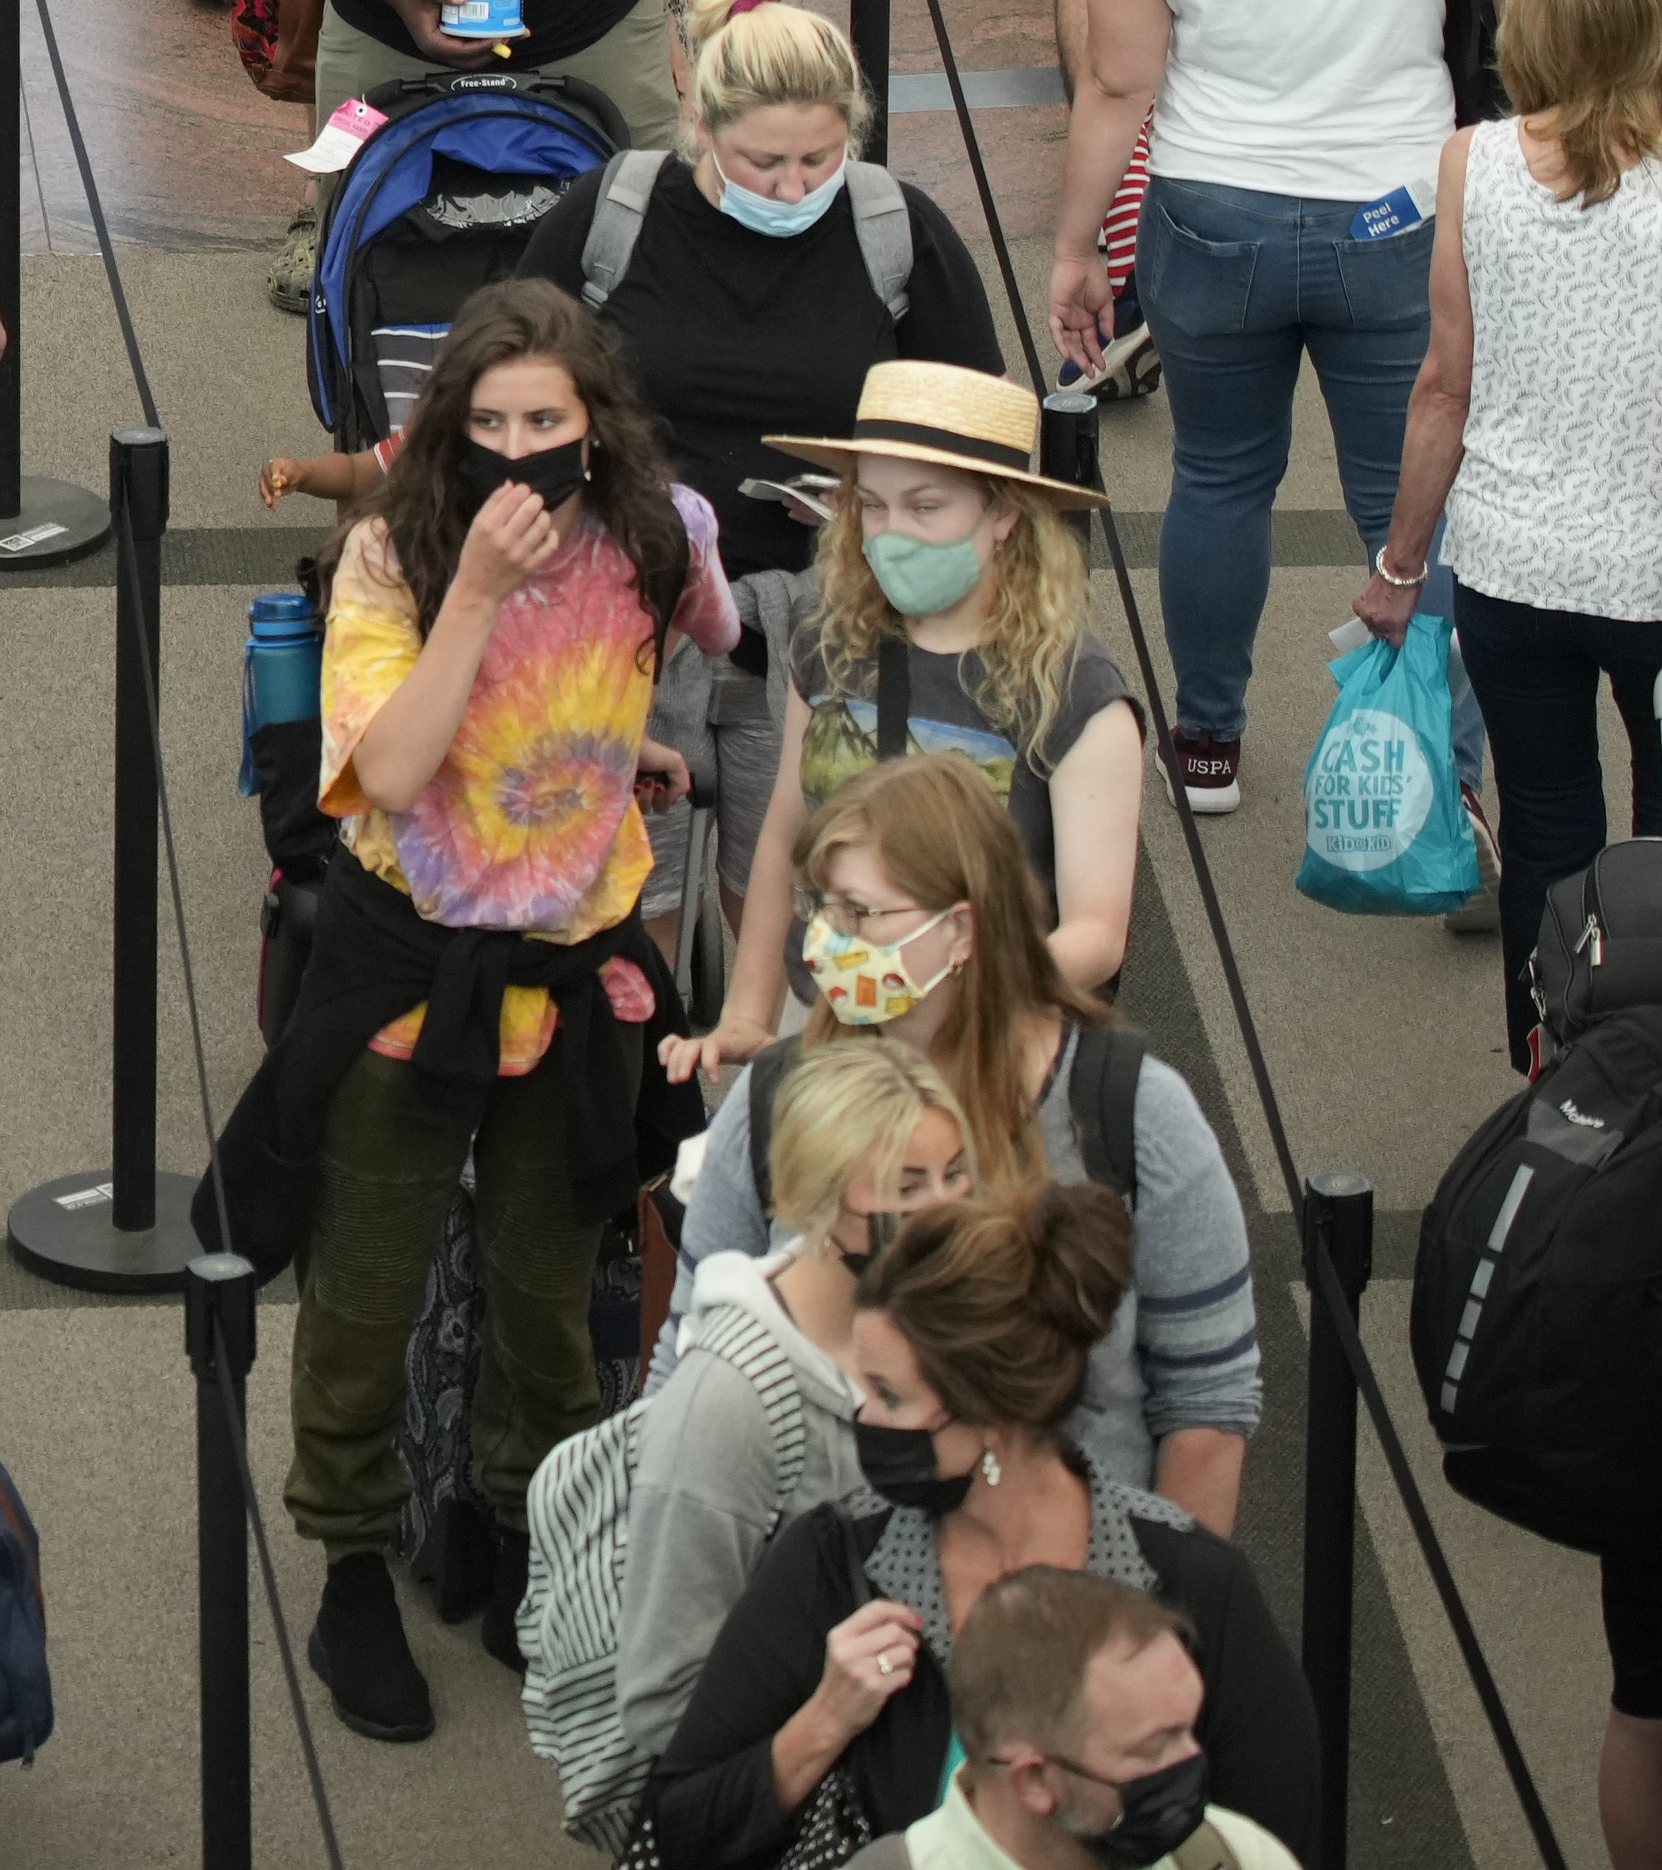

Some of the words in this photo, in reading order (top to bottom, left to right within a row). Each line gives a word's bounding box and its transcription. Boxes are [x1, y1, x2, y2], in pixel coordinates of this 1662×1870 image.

[461, 78, 506, 88] Free-Stand
[1363, 202, 1392, 224] Peel
[1368, 215, 1400, 237] Here
[1187, 758, 1232, 775] USPA
[1321, 740, 1405, 773] CASH
[1314, 775, 1350, 796] FOR
[1313, 799, 1402, 829] STUFF
